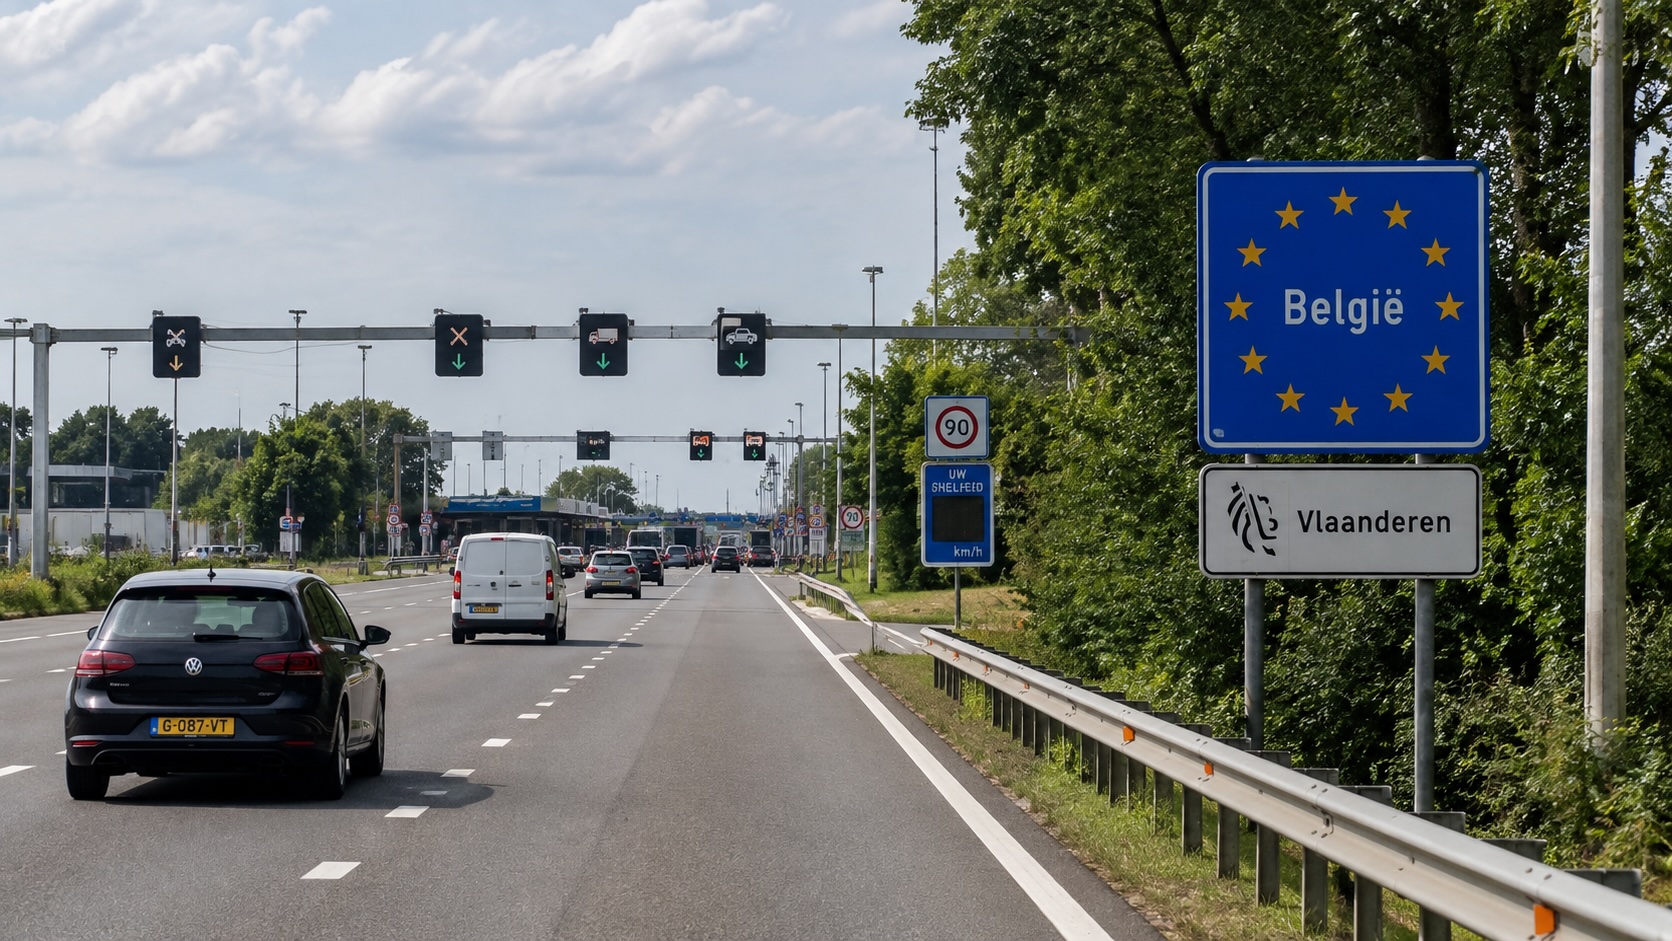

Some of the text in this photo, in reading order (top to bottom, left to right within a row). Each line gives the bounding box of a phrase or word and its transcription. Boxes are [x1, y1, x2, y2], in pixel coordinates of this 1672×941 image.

[1284, 288, 1404, 335] België
[945, 419, 969, 436] 90
[949, 469, 967, 480] UW
[1297, 510, 1452, 534] Vlaanderen
[953, 545, 983, 558] km/h
